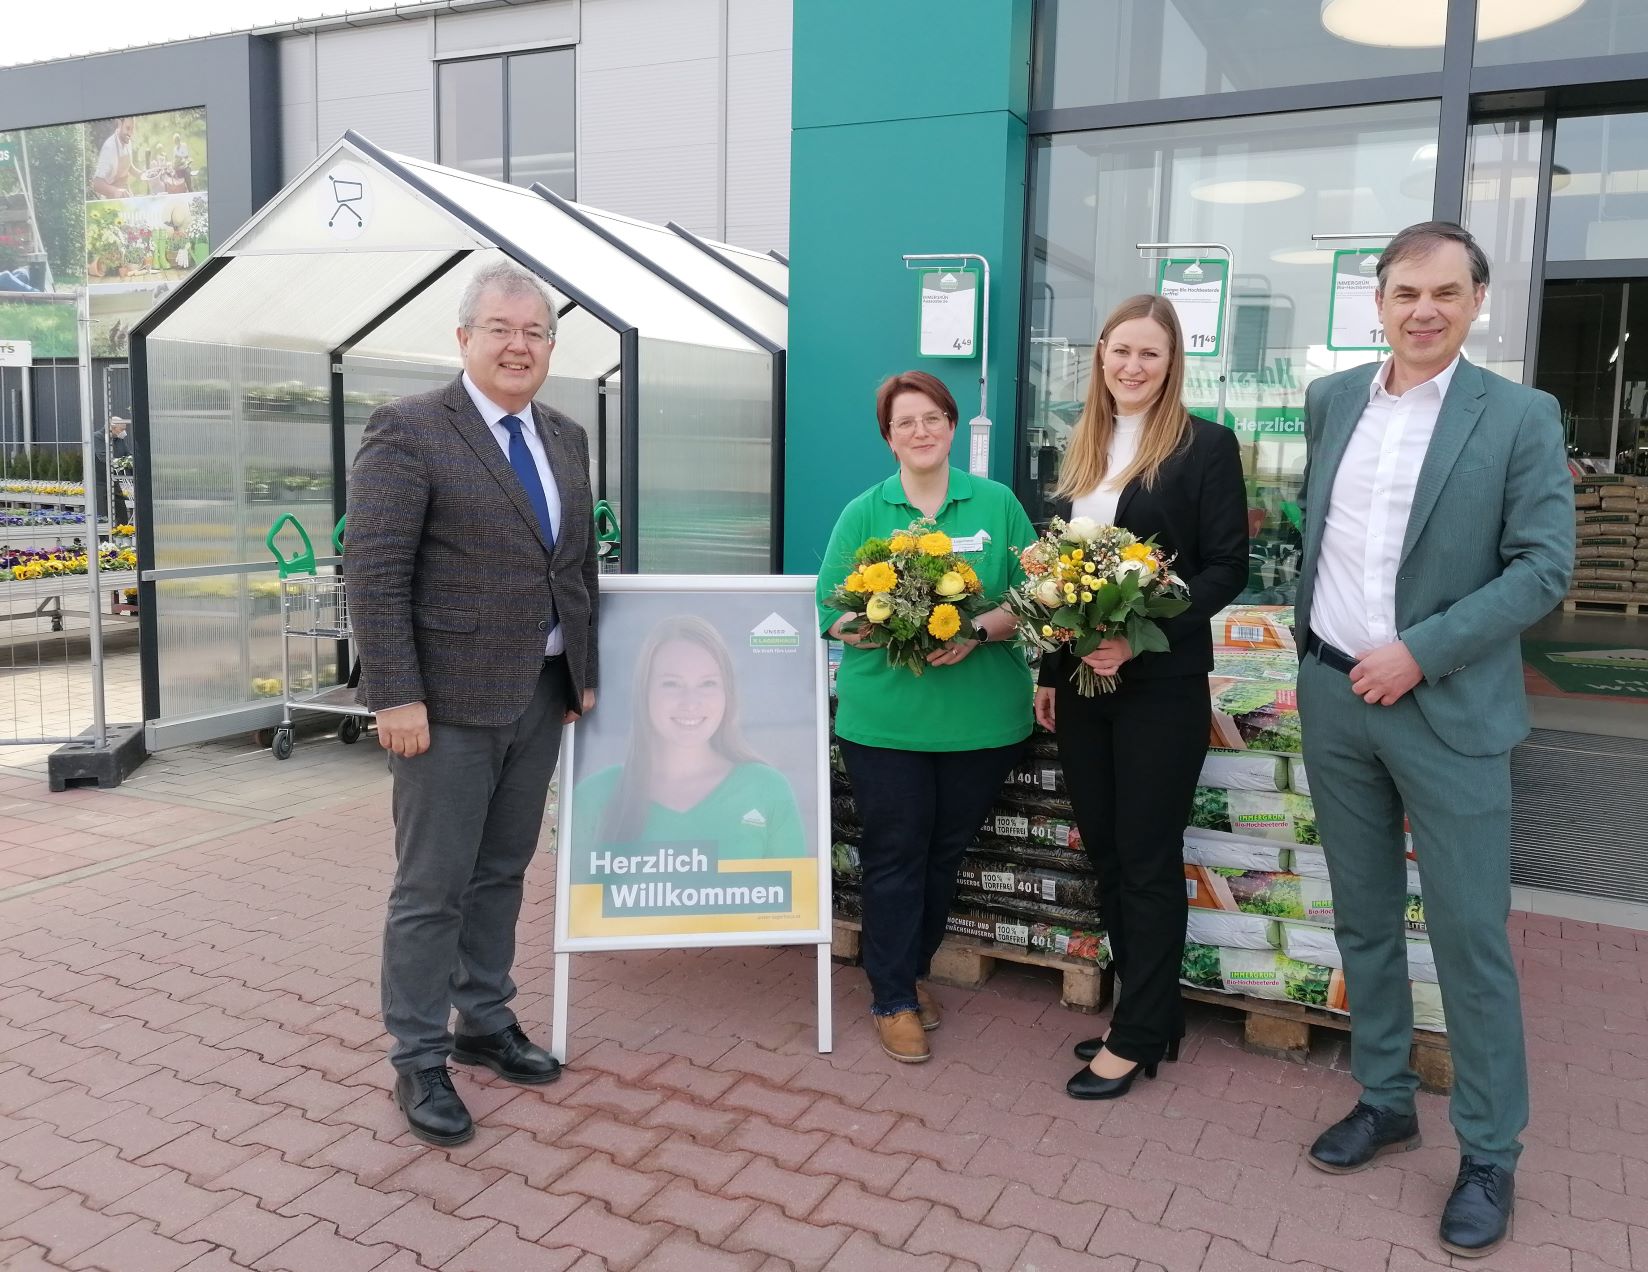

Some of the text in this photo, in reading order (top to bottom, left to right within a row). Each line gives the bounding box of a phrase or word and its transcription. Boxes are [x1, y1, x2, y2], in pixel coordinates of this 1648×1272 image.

[1017, 772, 1039, 785] 40 L
[997, 827, 1026, 835] TORFFREI
[1031, 826, 1044, 837] 40
[590, 848, 708, 875] Herzlich
[985, 882, 1013, 890] TORFFREI
[1018, 881, 1040, 894] 40 L
[610, 882, 784, 908] Willkommen
[978, 922, 990, 930] UND
[998, 934, 1026, 944] TORFFREI
[1031, 935, 1045, 946] 40
